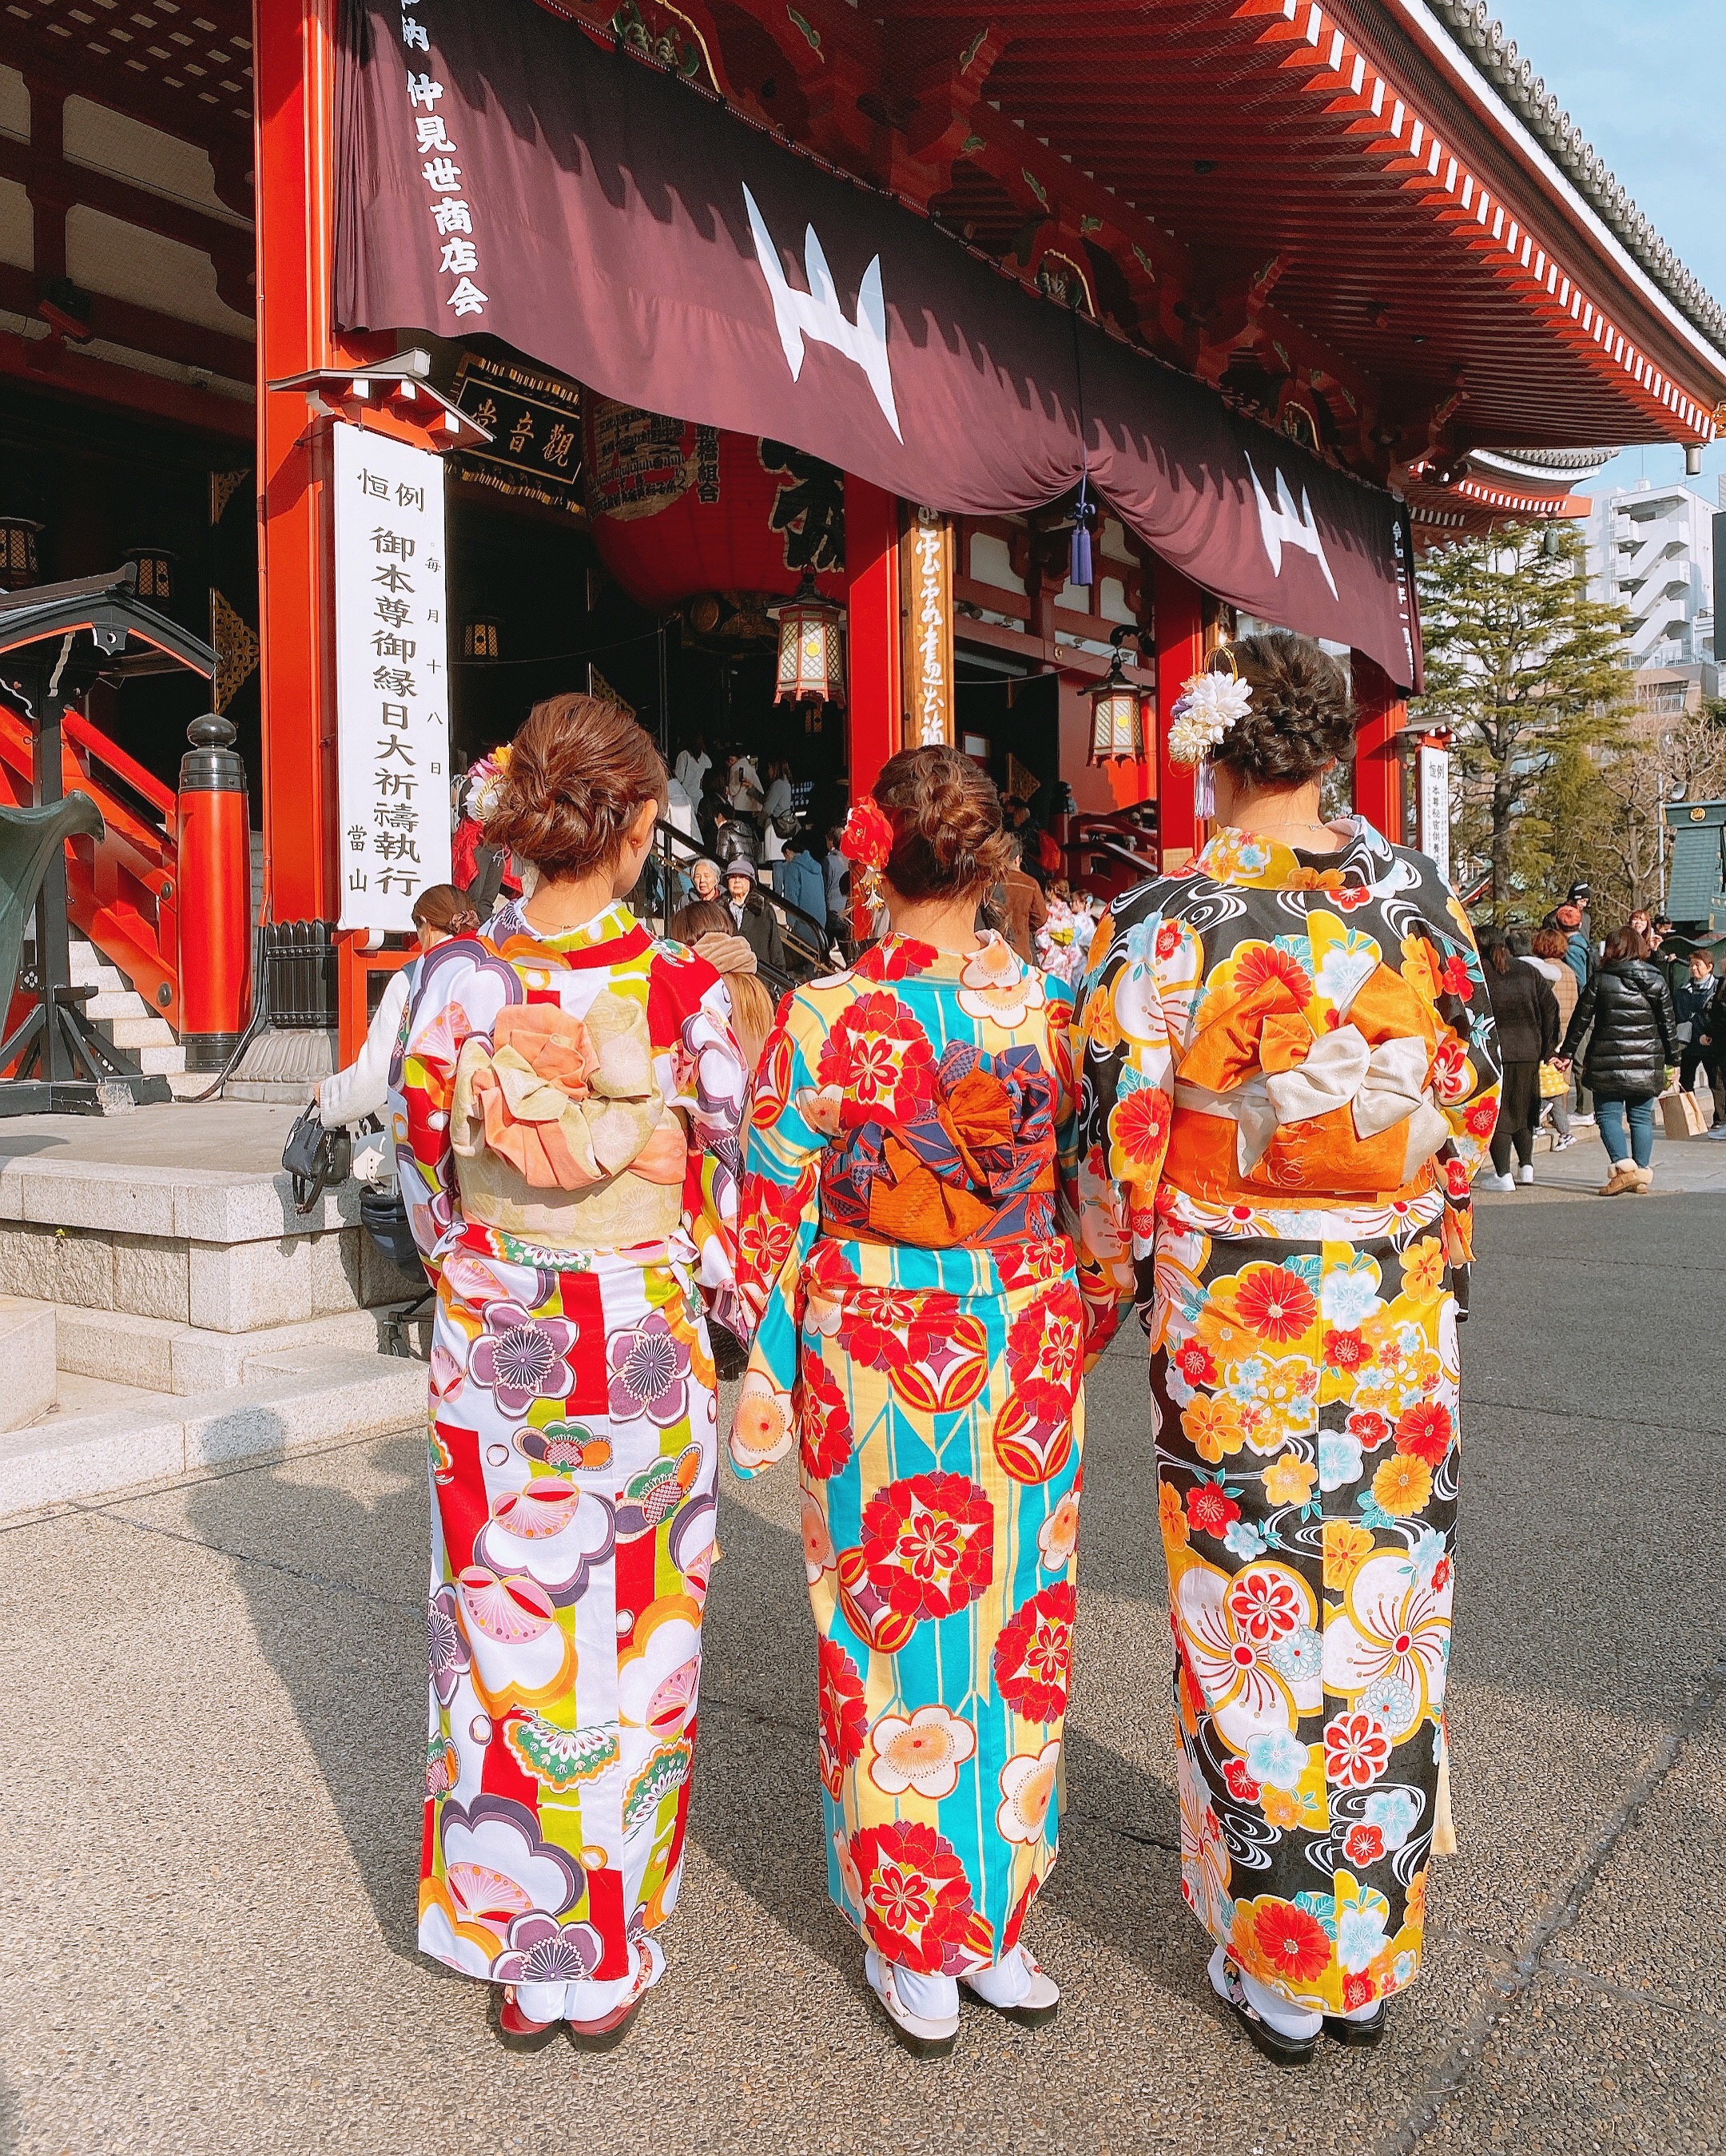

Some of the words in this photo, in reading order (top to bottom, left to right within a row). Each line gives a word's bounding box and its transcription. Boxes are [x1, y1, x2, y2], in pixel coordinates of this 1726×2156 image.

[400, 0, 431, 52] 納
[405, 70, 489, 318] 仲見世商店会
[356, 467, 425, 512] 恒例
[347, 825, 368, 893] 當山
